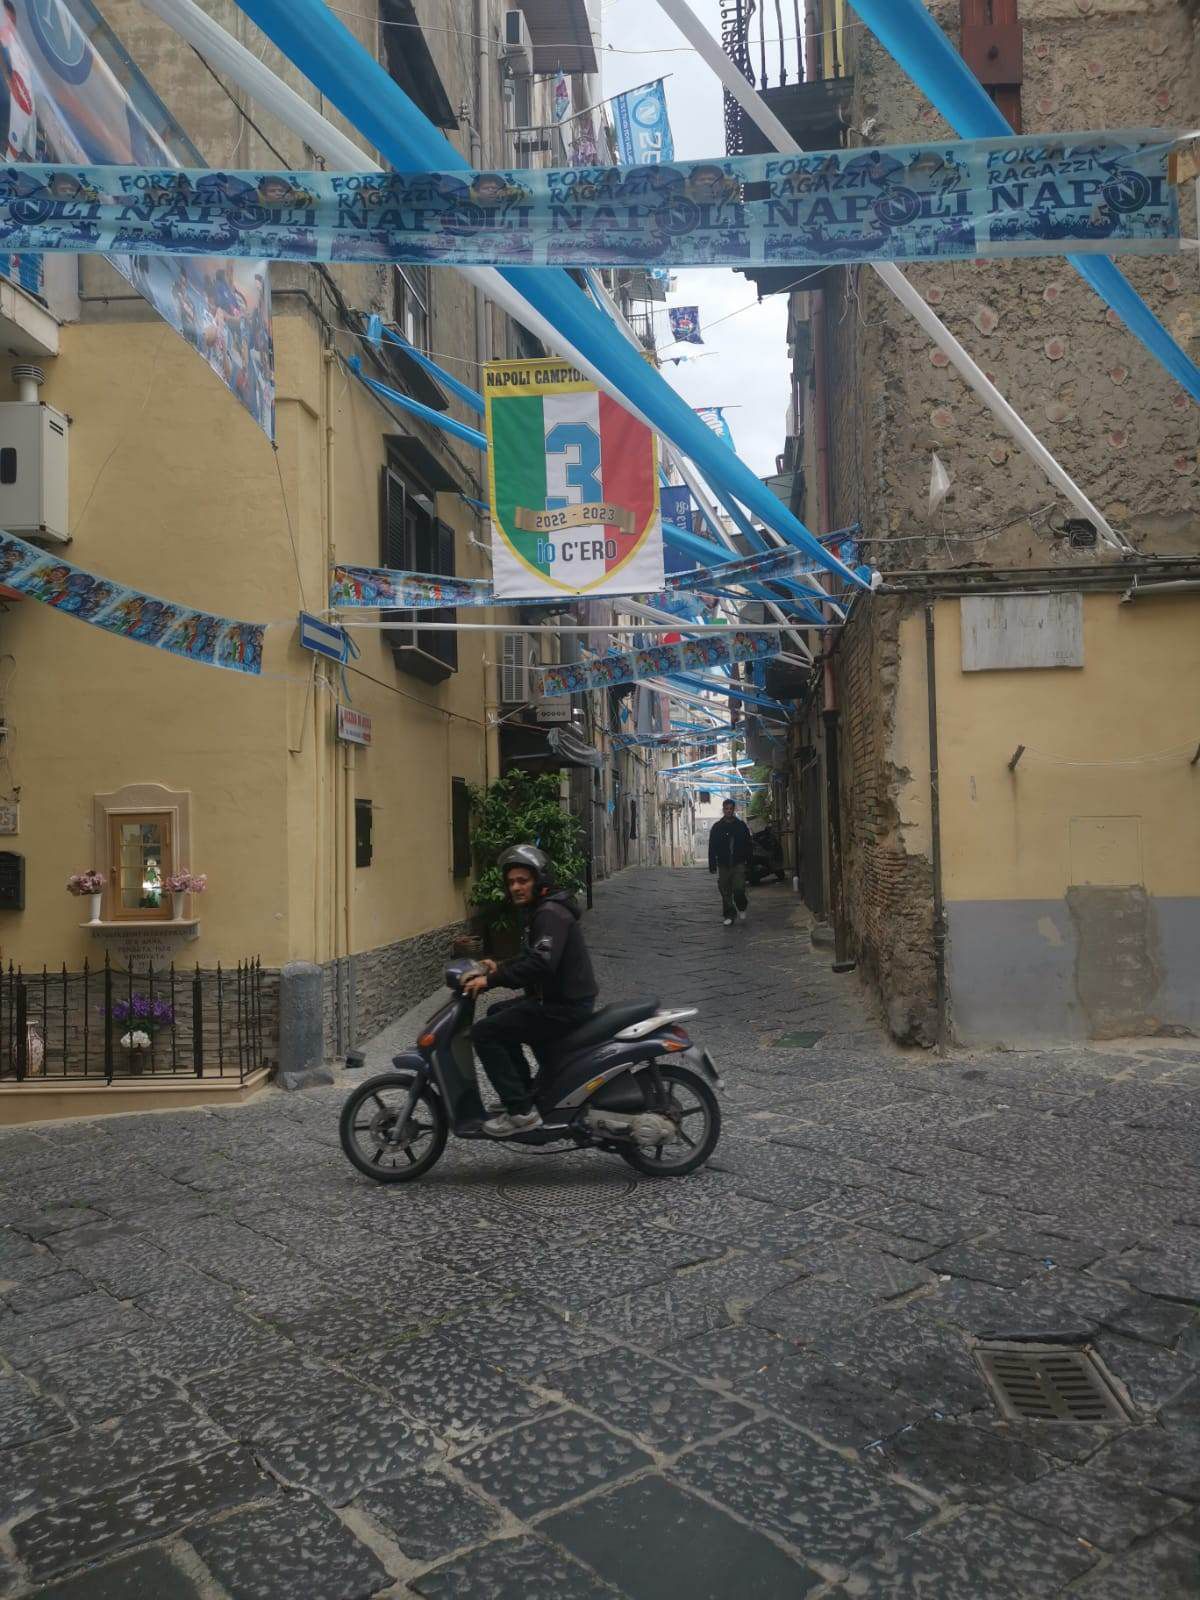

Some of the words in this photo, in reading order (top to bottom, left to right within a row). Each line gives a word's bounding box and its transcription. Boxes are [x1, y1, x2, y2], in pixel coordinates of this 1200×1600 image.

[765, 154, 841, 178] FORZA
[987, 144, 1067, 168] FORZA
[119, 171, 193, 192] FORZA
[331, 172, 405, 192] FORZA
[546, 167, 621, 187] FORZA
[988, 159, 1094, 184] RAGAZZI
[550, 182, 649, 204] RAGAZZI
[769, 170, 868, 198] RAGAZZI
[337, 189, 436, 209] RAGAZZI
[486, 370, 531, 387] NAPOLI
[544, 421, 604, 512] 3
[535, 512, 567, 529] 2022
[583, 507, 616, 522] 2023
[561, 539, 618, 562] C'ERO
